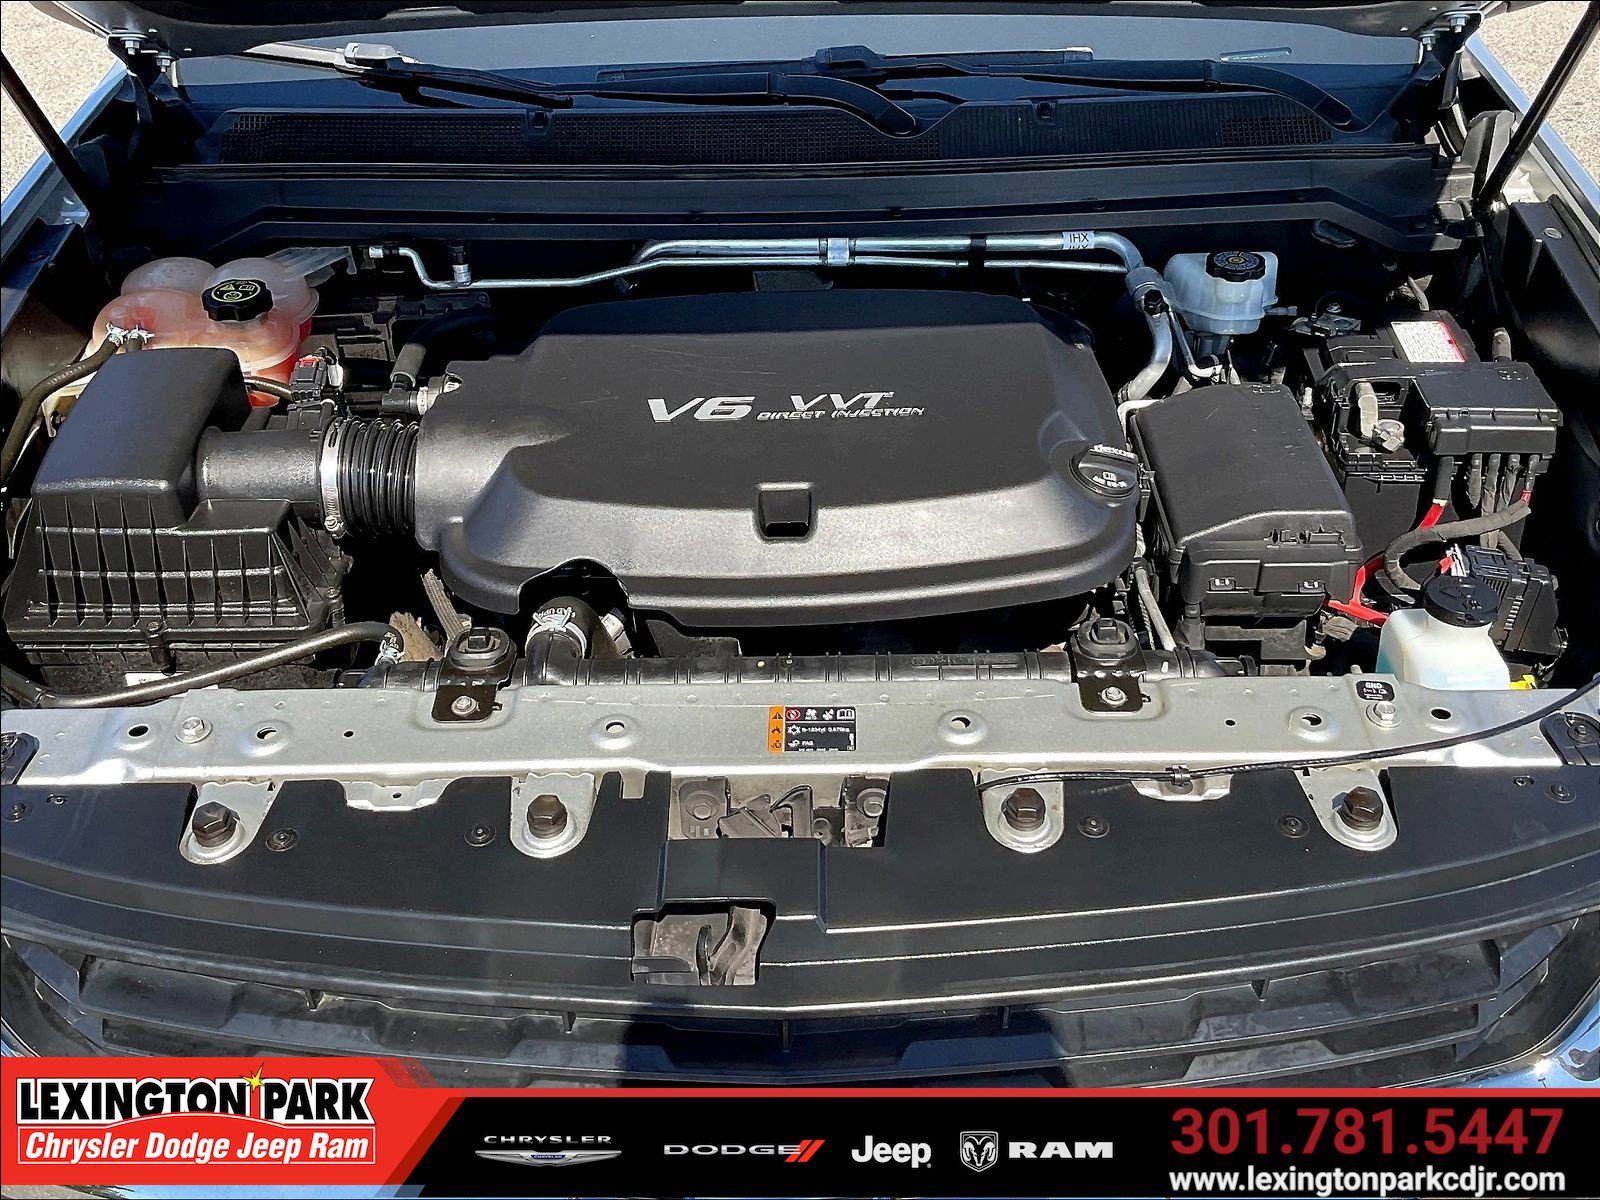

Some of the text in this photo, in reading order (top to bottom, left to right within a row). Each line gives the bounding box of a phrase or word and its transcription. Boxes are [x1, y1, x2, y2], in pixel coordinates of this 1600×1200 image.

[1069, 233, 1089, 243] IHX
[648, 391, 895, 423] V6 VVT
[756, 407, 925, 421] DIRECT INJECTION
